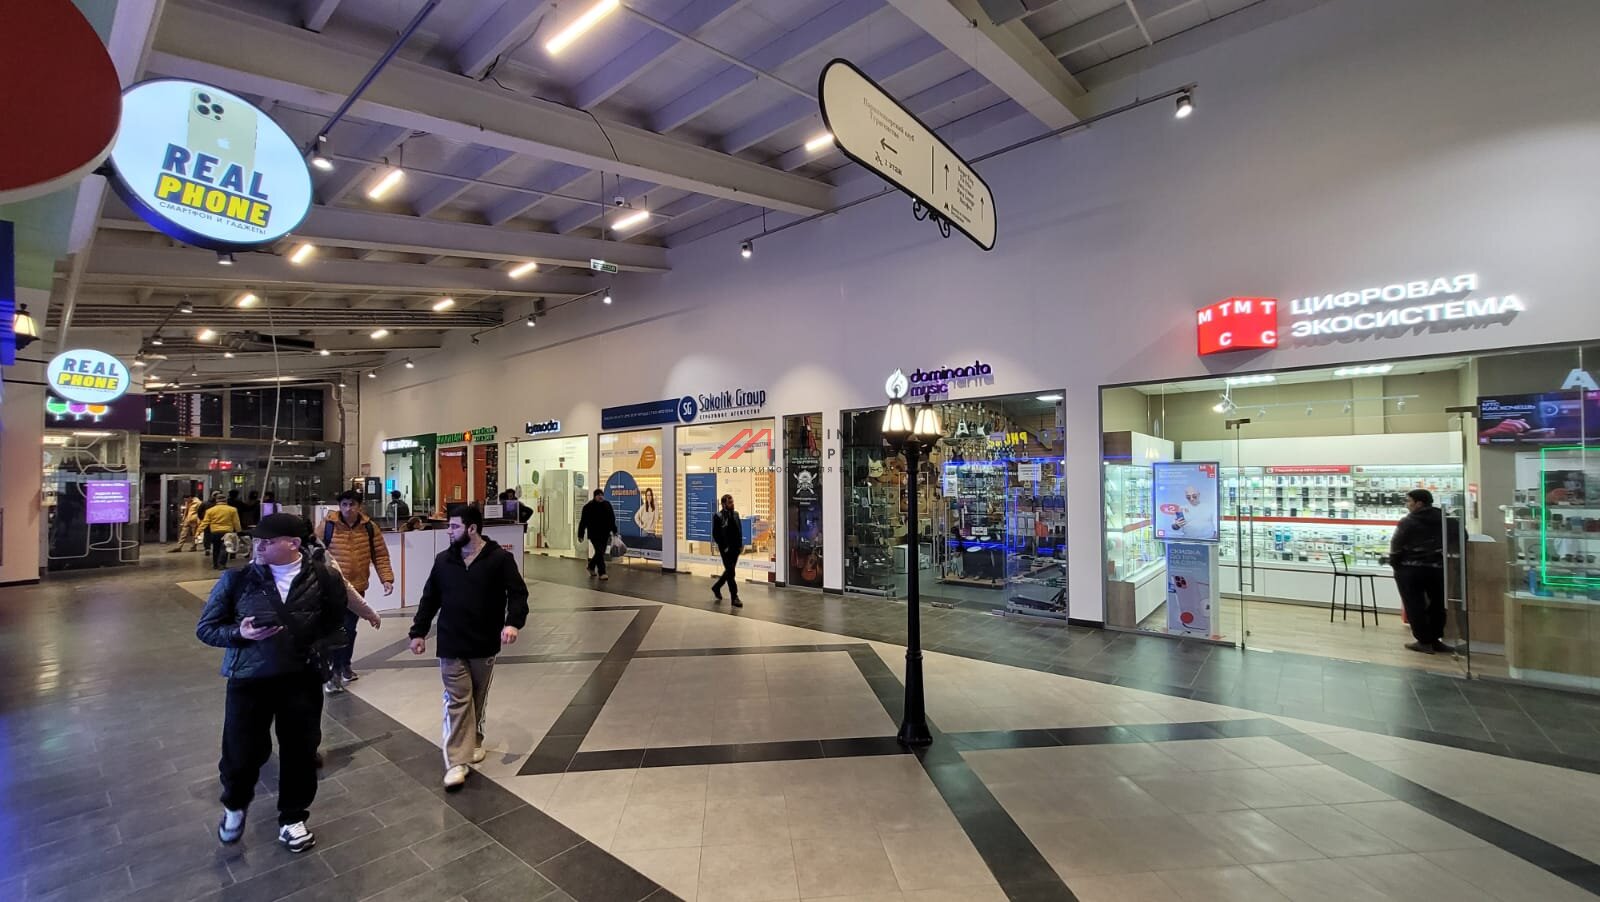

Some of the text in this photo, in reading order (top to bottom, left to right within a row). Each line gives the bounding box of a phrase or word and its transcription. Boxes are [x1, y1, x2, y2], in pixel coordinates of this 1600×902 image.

[161, 143, 269, 200] REAL
[156, 175, 271, 226] PHONE
[159, 201, 267, 235] СМАРТФОН И ГАДЖЕТЫ
[1290, 273, 1479, 315] ЦИФРОВАЯ
[1291, 294, 1526, 337] ЭКОСИСТЕМА
[62, 358, 119, 376] REAL
[911, 361, 992, 383] dominanta
[57, 372, 118, 390] PHONE
[911, 381, 948, 396] music
[682, 401, 693, 416] SG
[698, 388, 766, 411] Sokolik Group
[699, 408, 760, 420] СТРАХОВОЕ АГЕНТСТВО
[526, 420, 560, 435] lamoda
